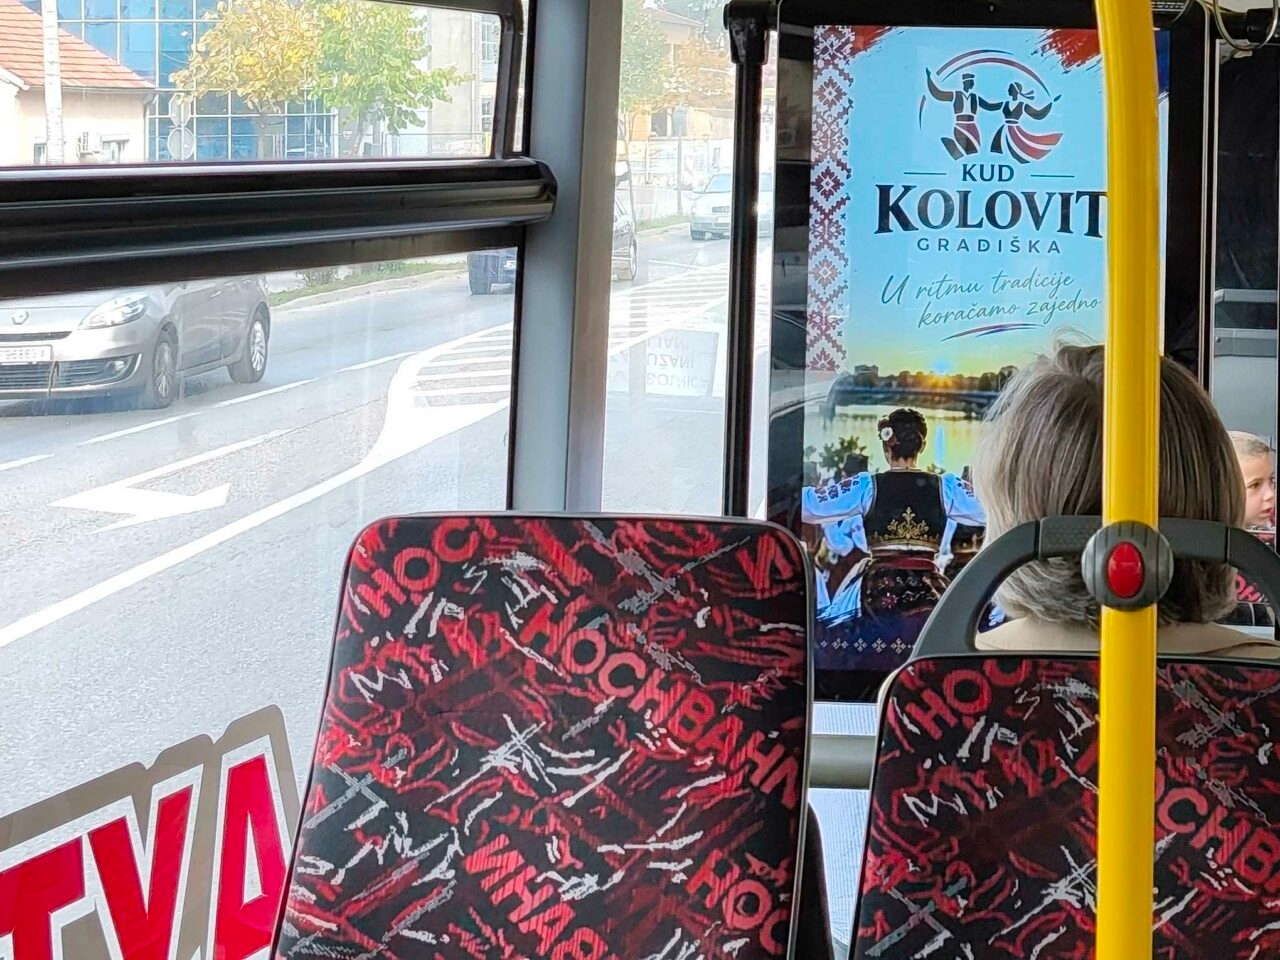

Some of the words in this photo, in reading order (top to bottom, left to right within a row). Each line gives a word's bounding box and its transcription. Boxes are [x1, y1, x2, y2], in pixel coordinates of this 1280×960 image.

[961, 163, 1015, 182] KUD
[874, 184, 1108, 238] KOLOVIT
[917, 236, 1061, 254] GRADIŠKA
[881, 274, 910, 305] U
[915, 273, 984, 300] ritmu
[991, 266, 1075, 298] tradicije
[917, 301, 1021, 328] koračamo
[1026, 289, 1102, 324] zajedno
